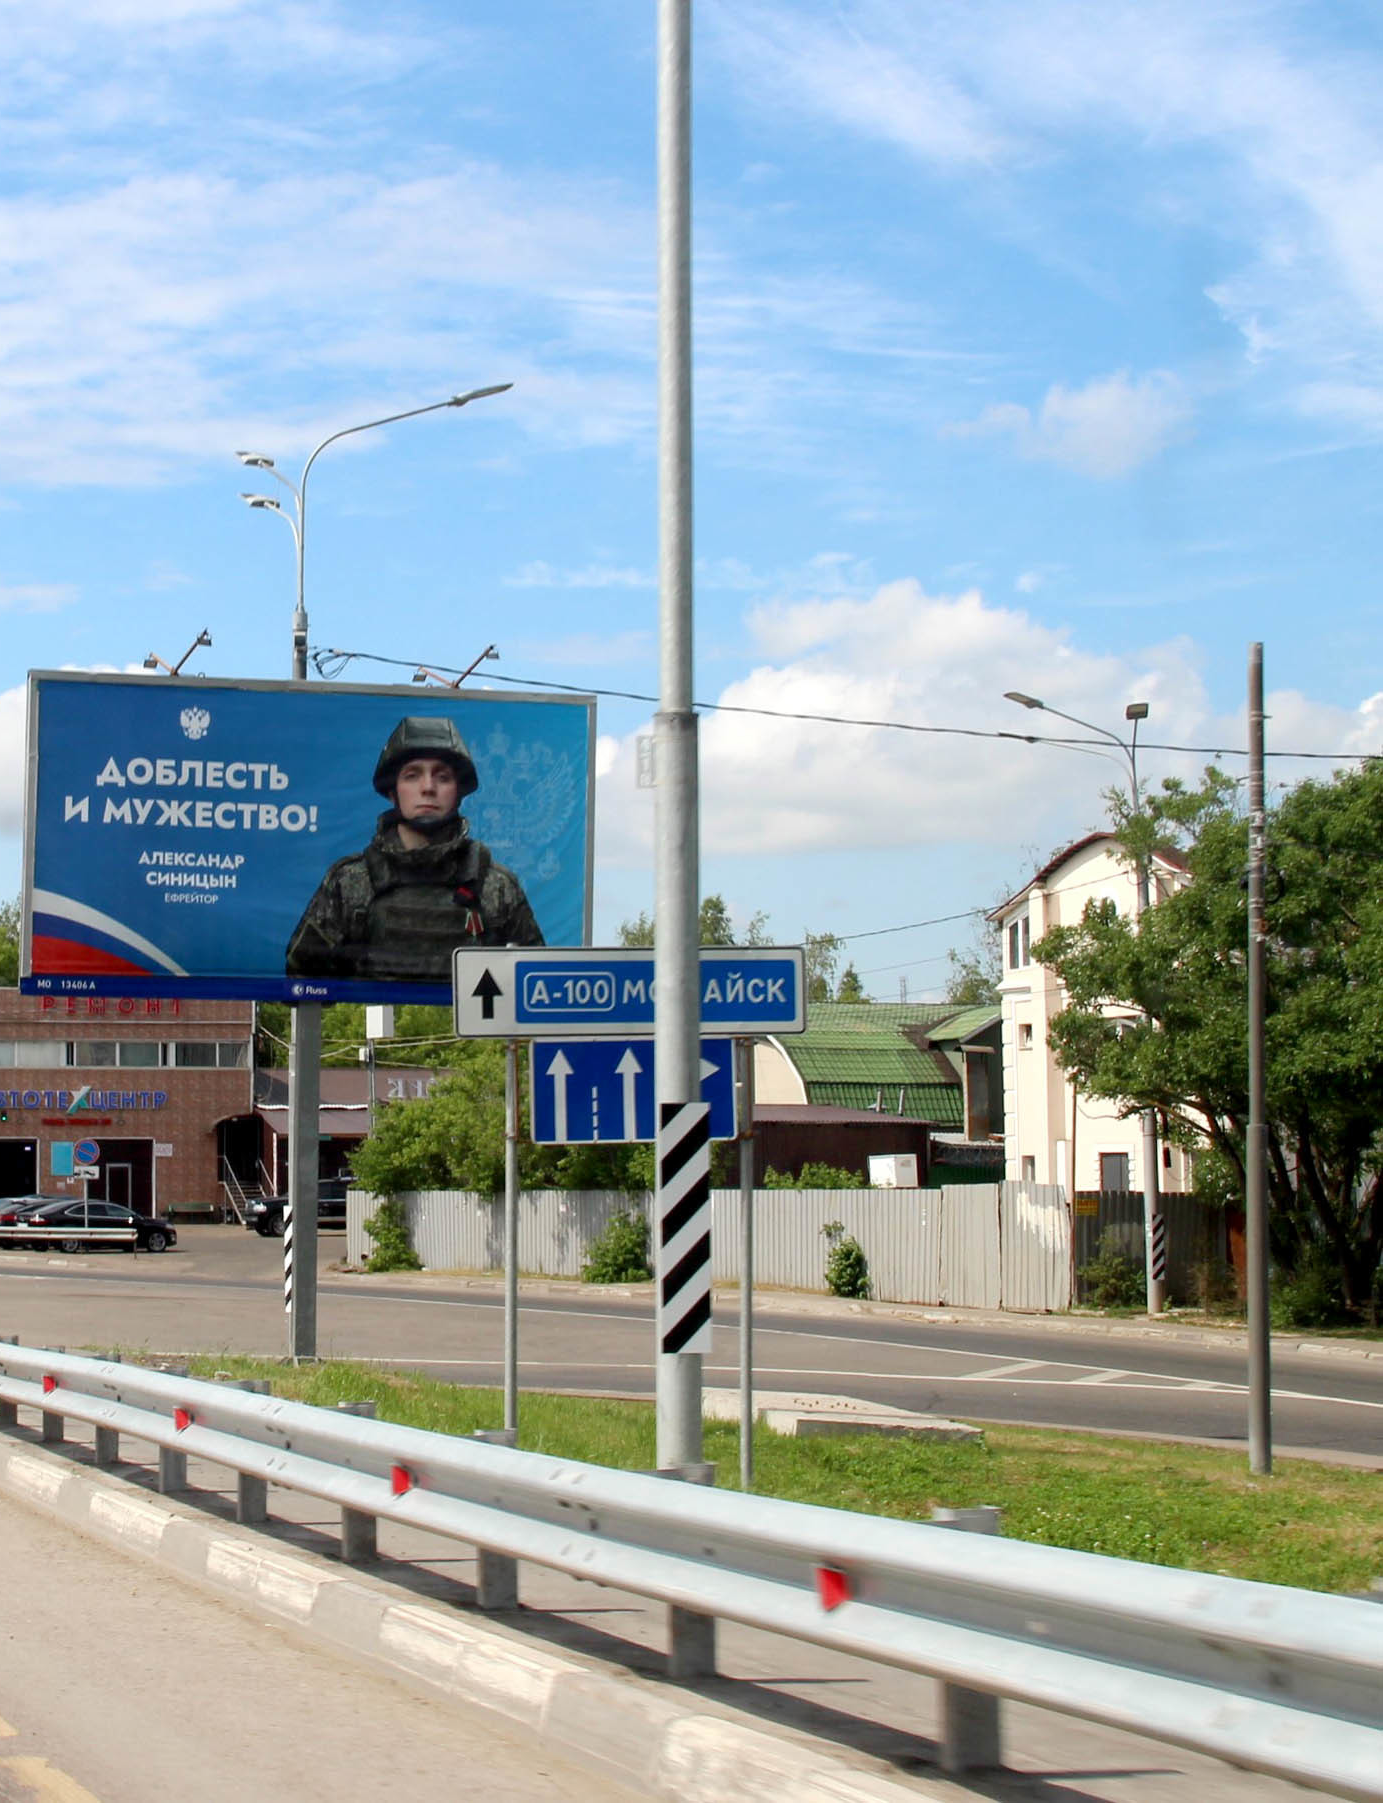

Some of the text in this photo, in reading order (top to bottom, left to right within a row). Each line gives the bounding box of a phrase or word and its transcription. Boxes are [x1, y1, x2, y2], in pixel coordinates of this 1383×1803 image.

[96, 757, 289, 791] ДОБЛЕСТЬ
[65, 796, 318, 832] И МУЖЕСТВО!
[138, 851, 245, 869] АЛЕКСАНДР
[146, 871, 237, 888] СИНИЦЫН
[164, 891, 219, 905] ЕФРЕЙТОР
[305, 985, 328, 995] Russ
[530, 971, 786, 1004] А-100 МАЙСК
